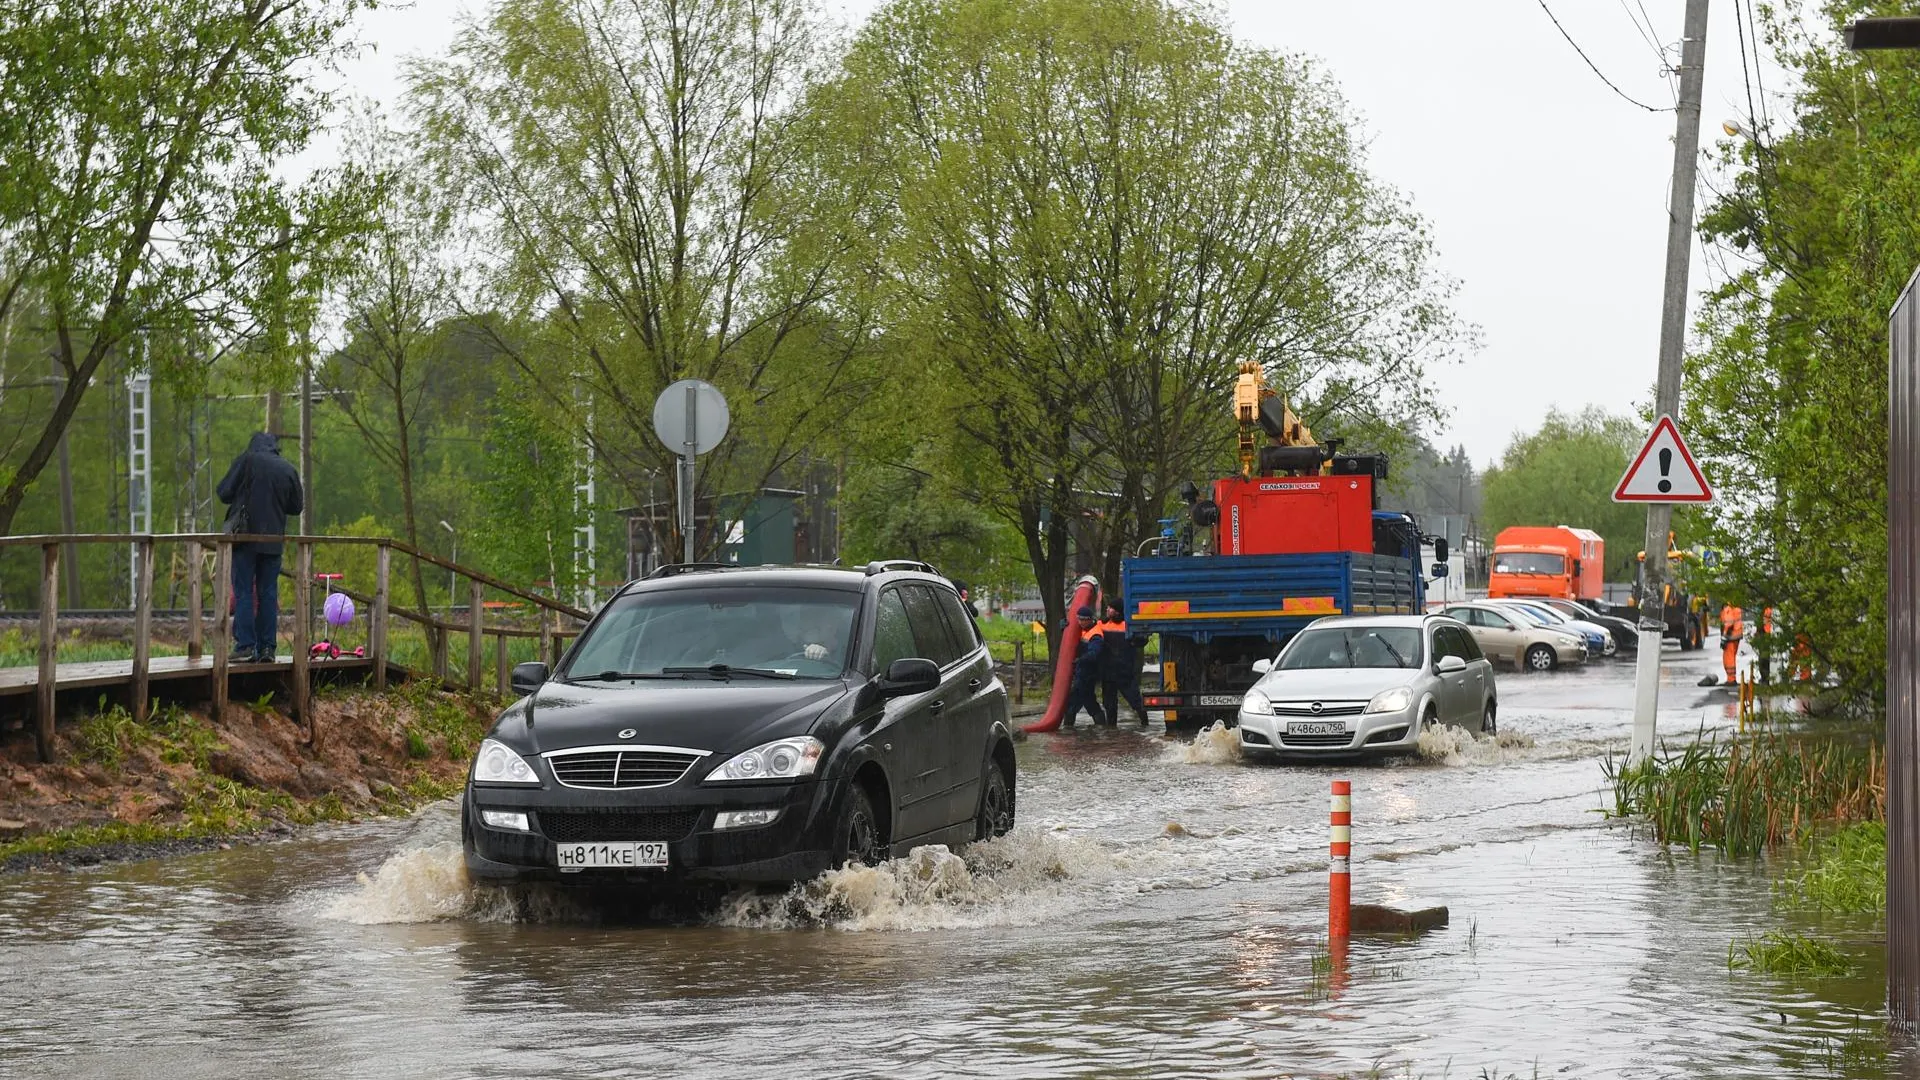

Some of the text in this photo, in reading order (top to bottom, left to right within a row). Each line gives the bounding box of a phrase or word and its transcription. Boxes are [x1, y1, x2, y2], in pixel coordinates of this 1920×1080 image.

[1329, 723, 1343, 731] 750
[563, 844, 663, 864] Н811КЕ 197
